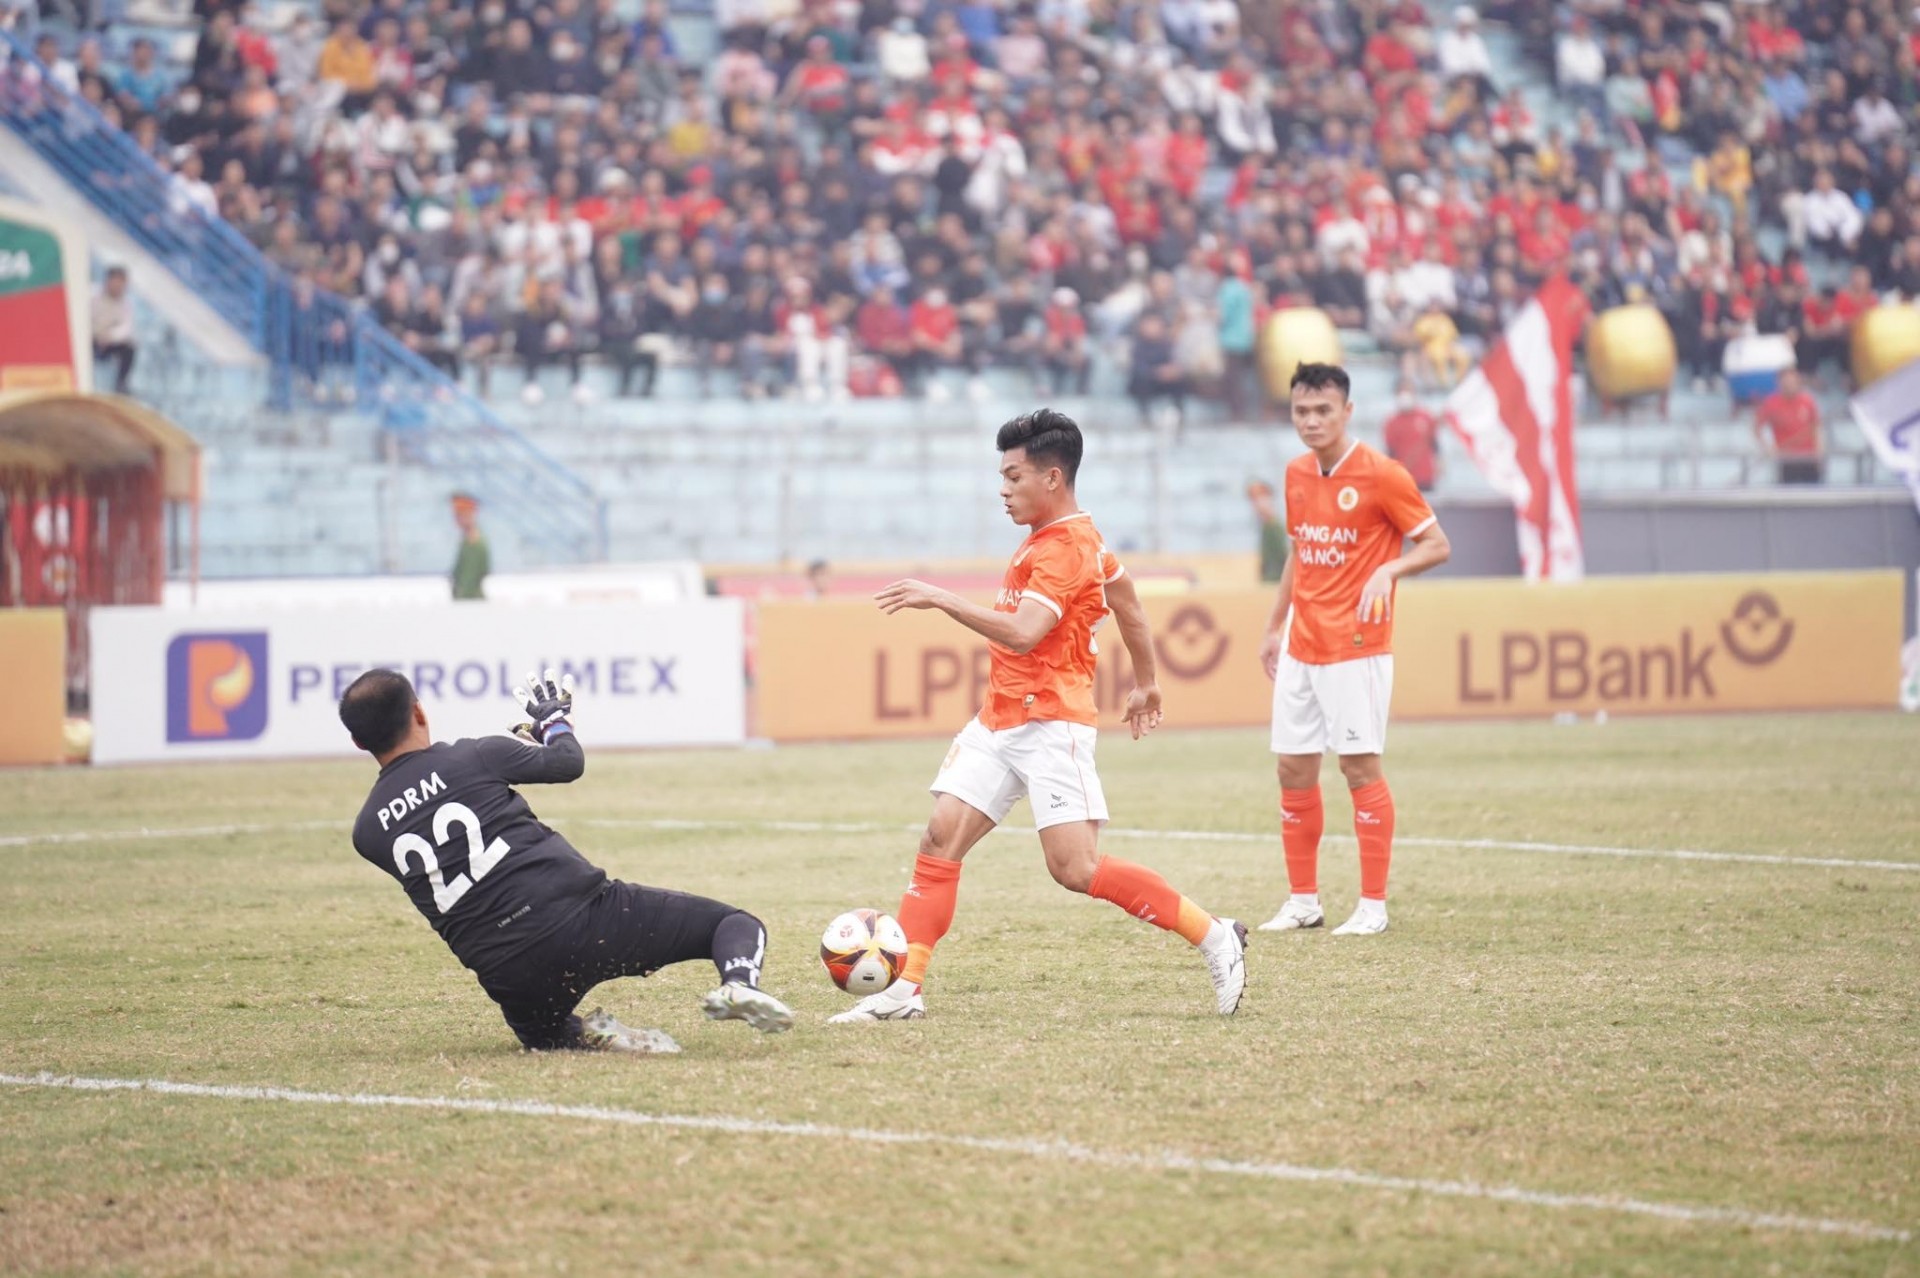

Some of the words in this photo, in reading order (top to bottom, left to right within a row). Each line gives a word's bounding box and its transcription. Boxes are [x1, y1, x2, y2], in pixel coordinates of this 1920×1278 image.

[1315, 546, 1345, 568] NỘI
[1330, 527, 1358, 545] AN
[290, 656, 679, 703] PEROLIMEX
[1458, 626, 1717, 703] LPBank
[377, 771, 448, 831] PDRM
[392, 801, 511, 914] 22
